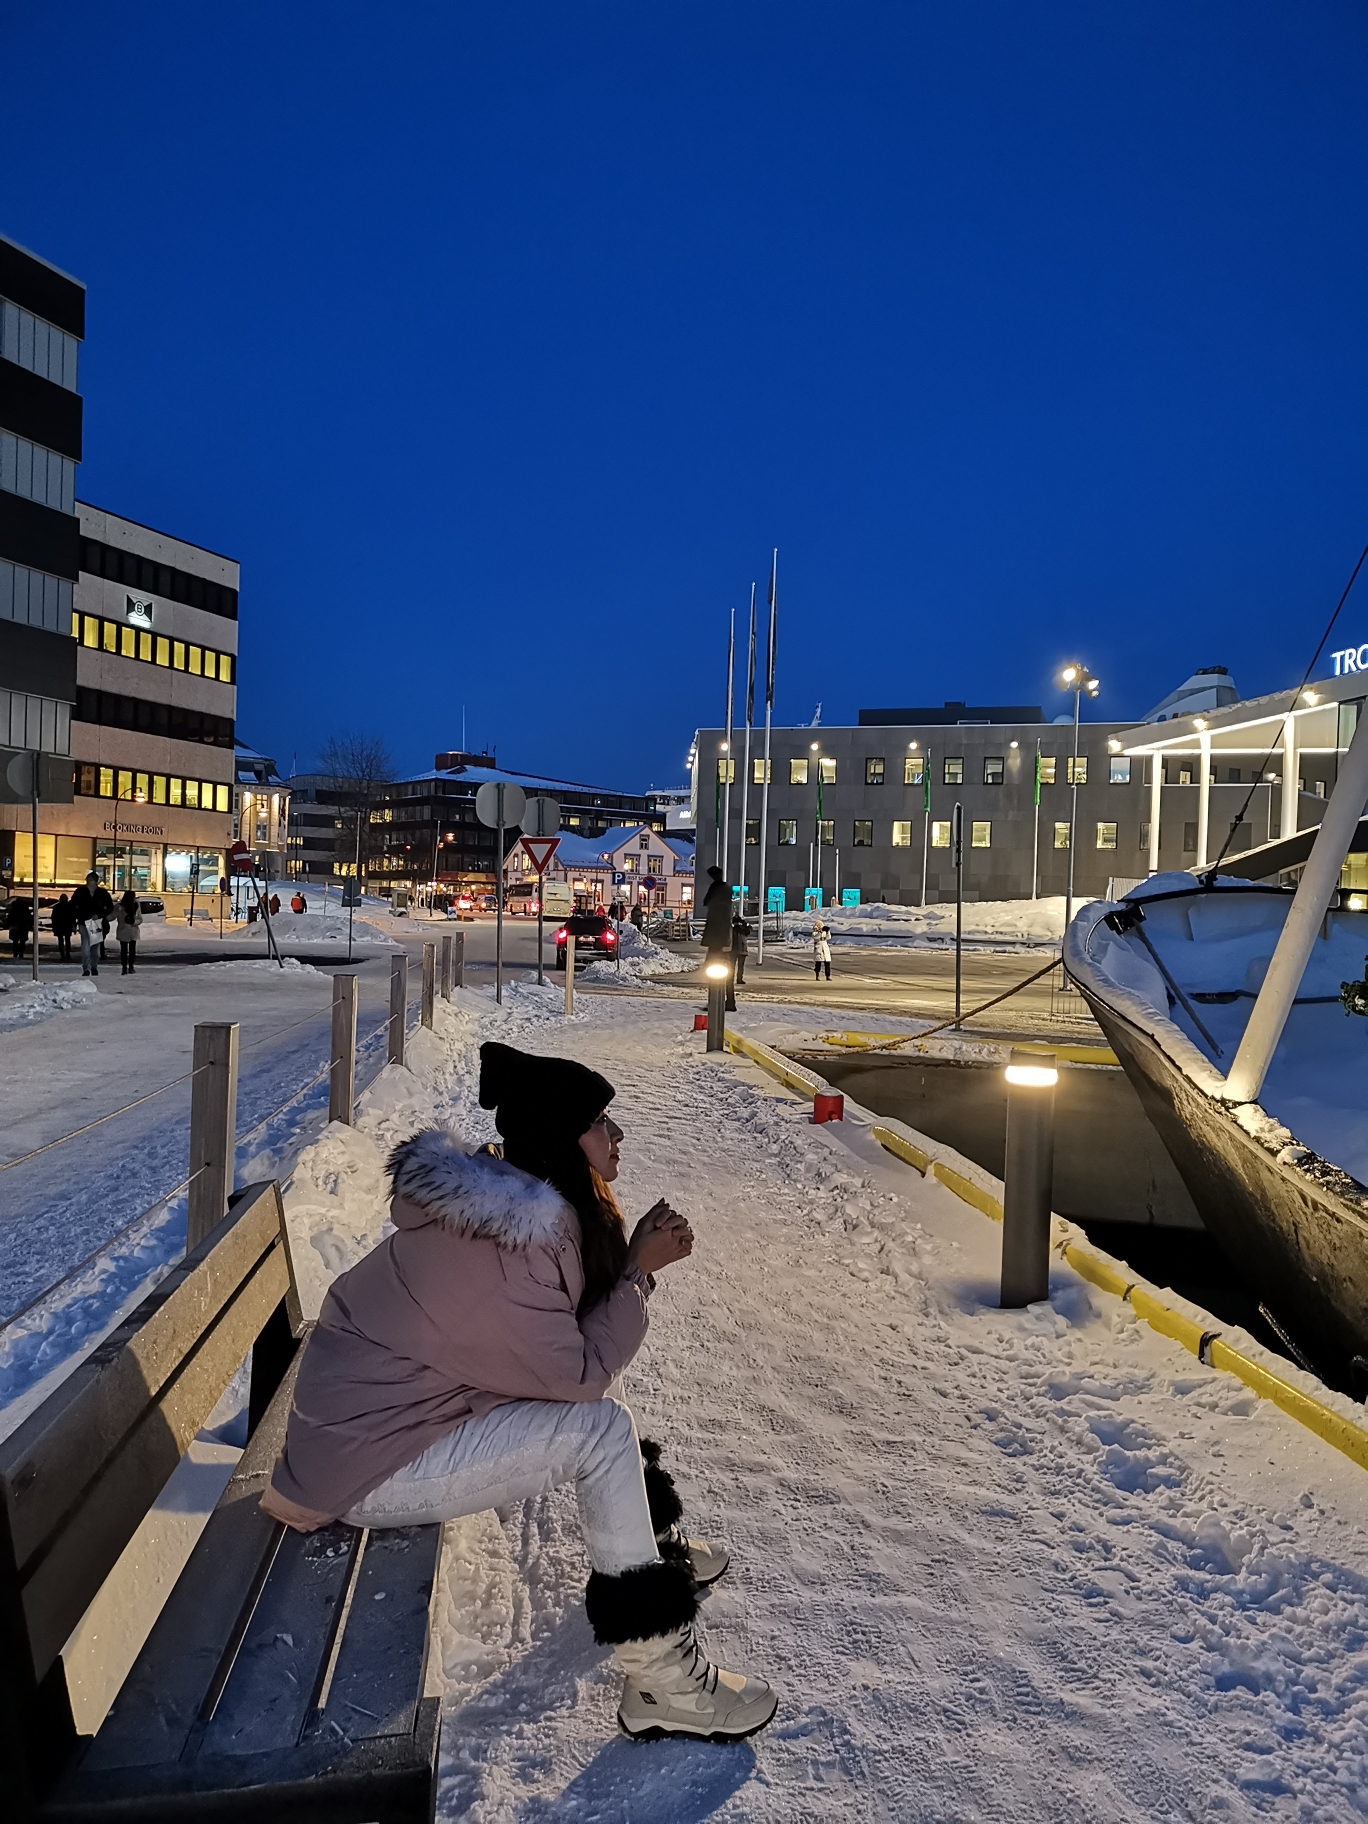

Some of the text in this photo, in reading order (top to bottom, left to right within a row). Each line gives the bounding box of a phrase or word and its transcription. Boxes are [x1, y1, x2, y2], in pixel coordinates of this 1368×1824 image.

[104, 822, 165, 835] BOOKING POINT
[615, 873, 623, 884] P
